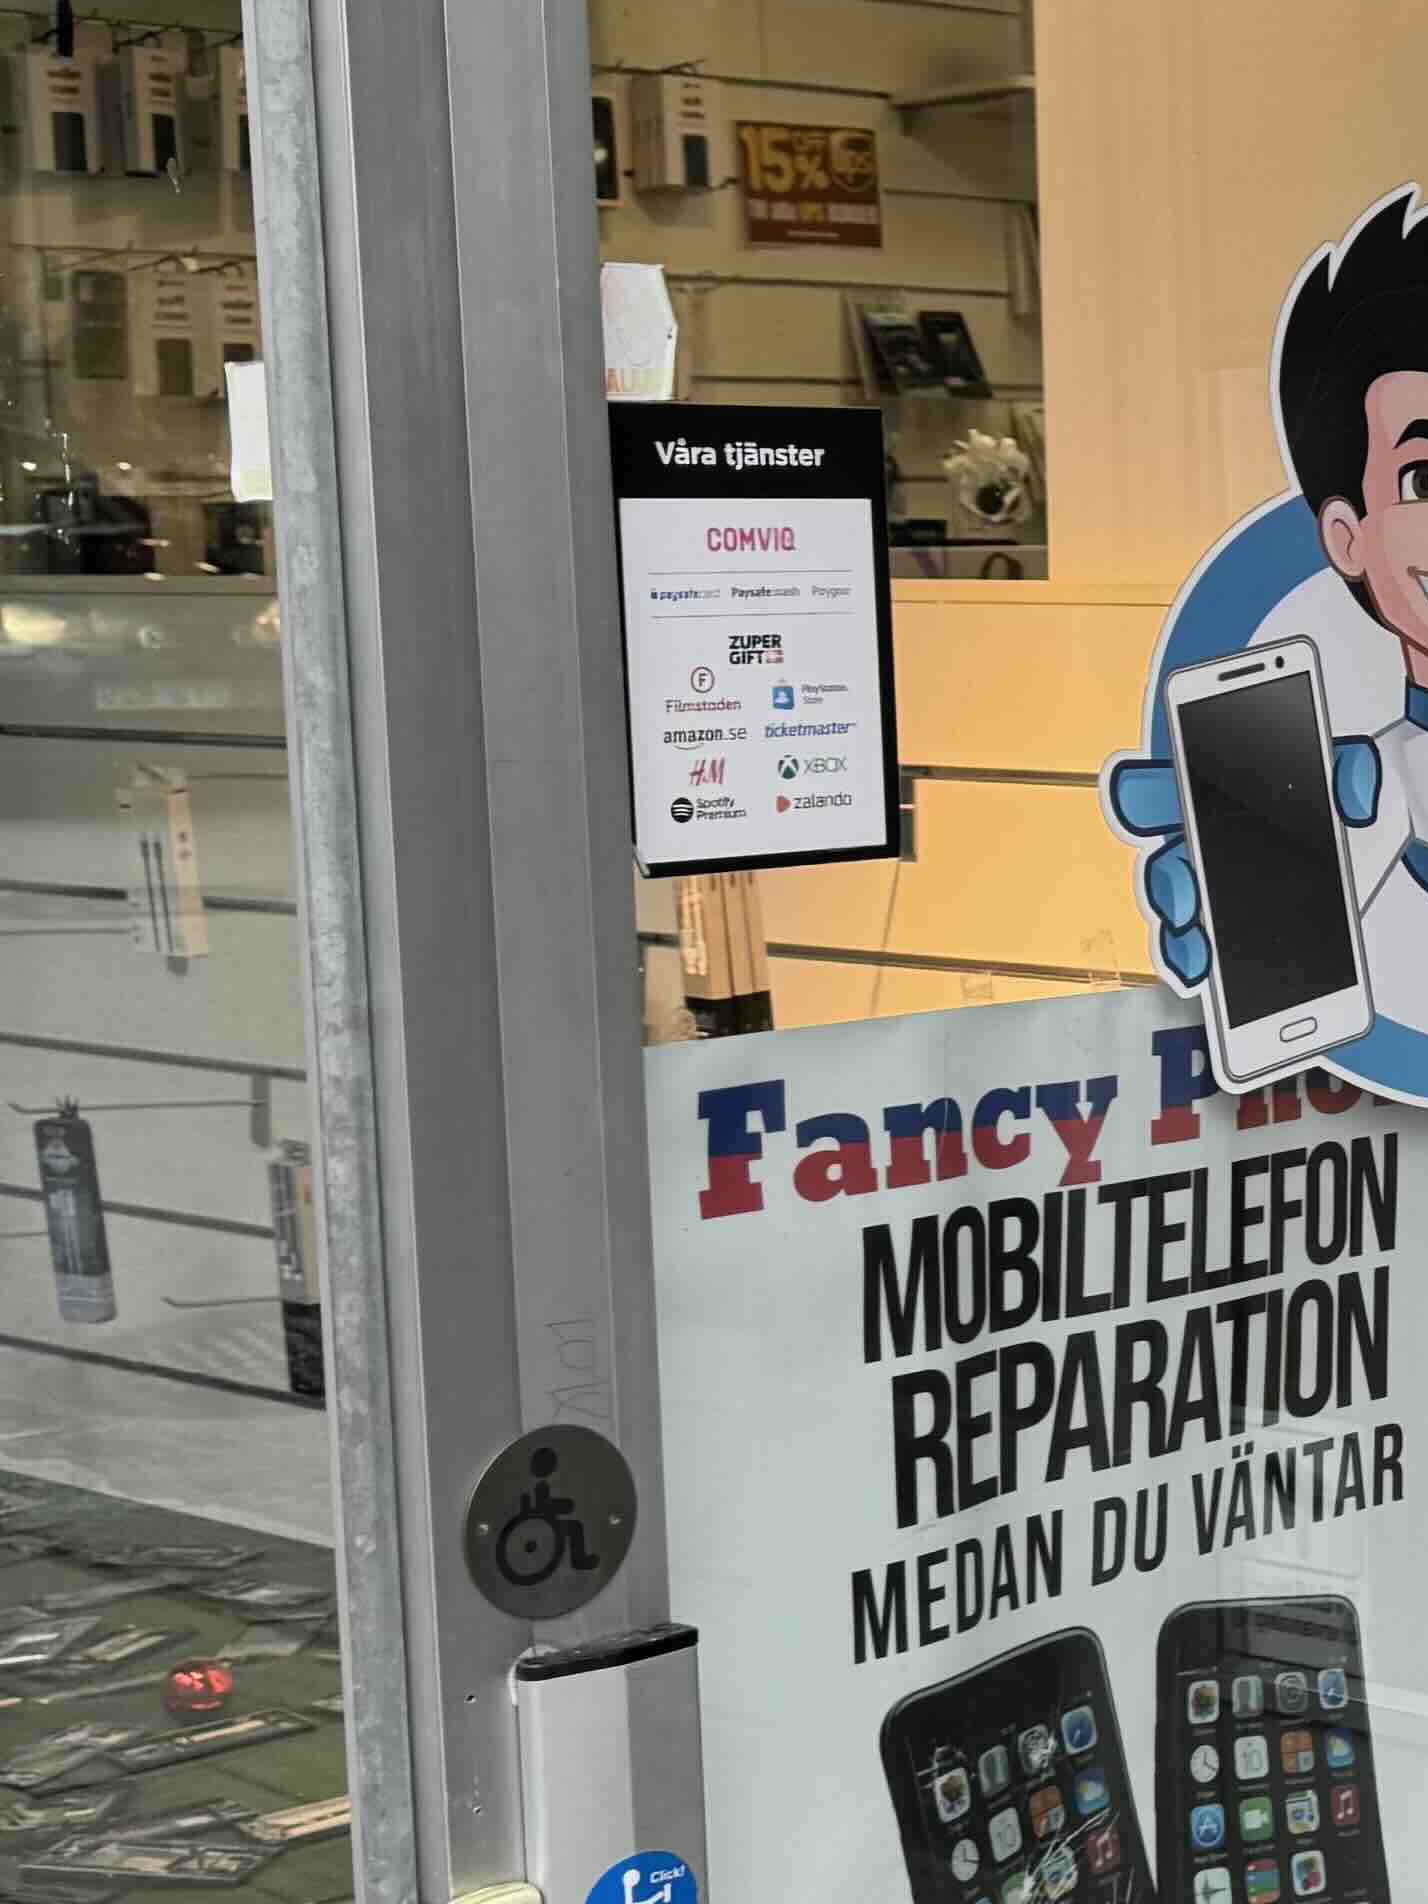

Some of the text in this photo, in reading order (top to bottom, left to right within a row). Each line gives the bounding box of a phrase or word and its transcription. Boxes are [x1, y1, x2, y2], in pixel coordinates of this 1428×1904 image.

[654, 437, 825, 471] Våra tjänster
[705, 526, 796, 552] COMVIQ
[728, 634, 782, 649] ZUPER
[729, 650, 765, 665] GIFT
[663, 725, 748, 745] amazon.se
[764, 720, 850, 740] ticketmaster
[794, 792, 852, 810] zalando
[698, 1074, 1119, 1221] Fancy
[862, 1132, 1399, 1365] MOBILTELEFON
[891, 1266, 1389, 1530] REPARATION
[851, 1423, 1405, 1665] MEDAN DU VÄNTAR
[649, 1864, 685, 1884] Click!
